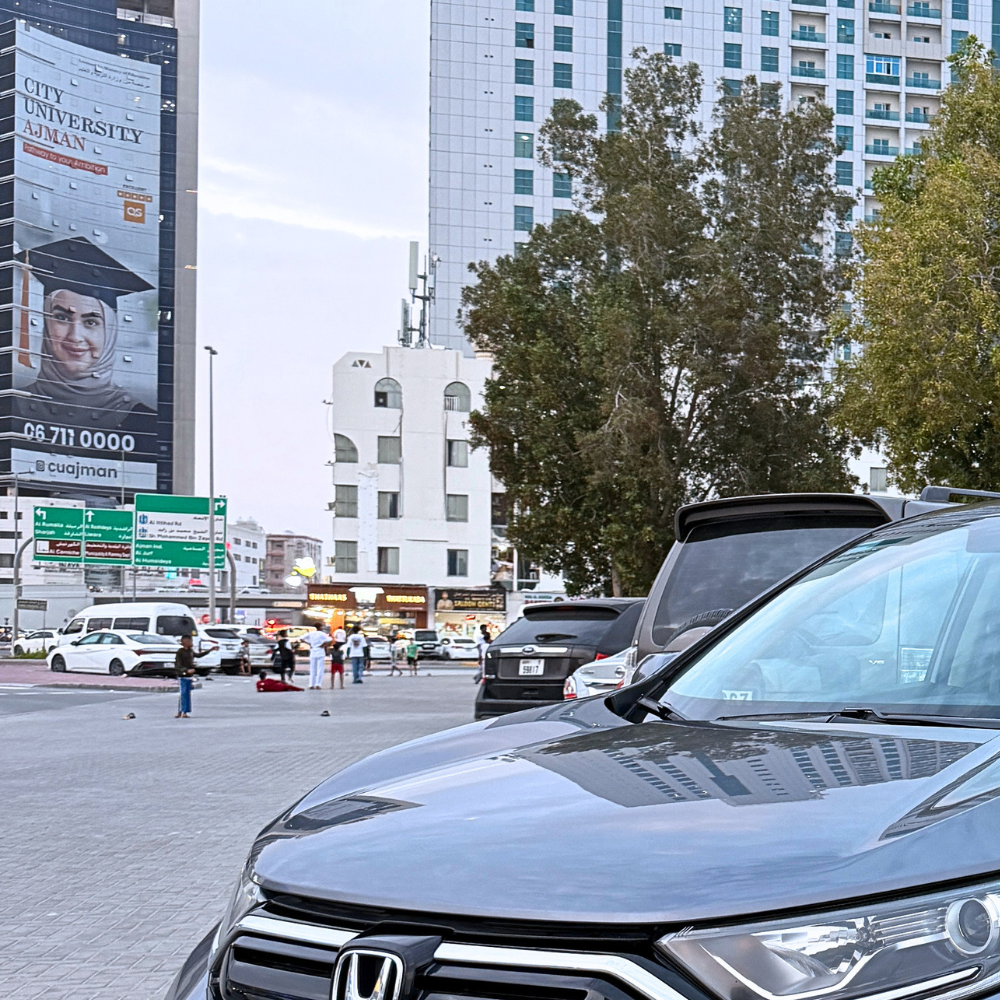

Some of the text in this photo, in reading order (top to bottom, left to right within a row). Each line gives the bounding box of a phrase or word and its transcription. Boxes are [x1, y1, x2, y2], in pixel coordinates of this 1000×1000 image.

[24, 77, 64, 104] CITY
[24, 97, 145, 144] UNIVERSITY
[23, 119, 86, 151] AJMAN
[126, 206, 143, 217] QS
[24, 422, 135, 452] 06 711 0000
[48, 462, 118, 479] cuajman
